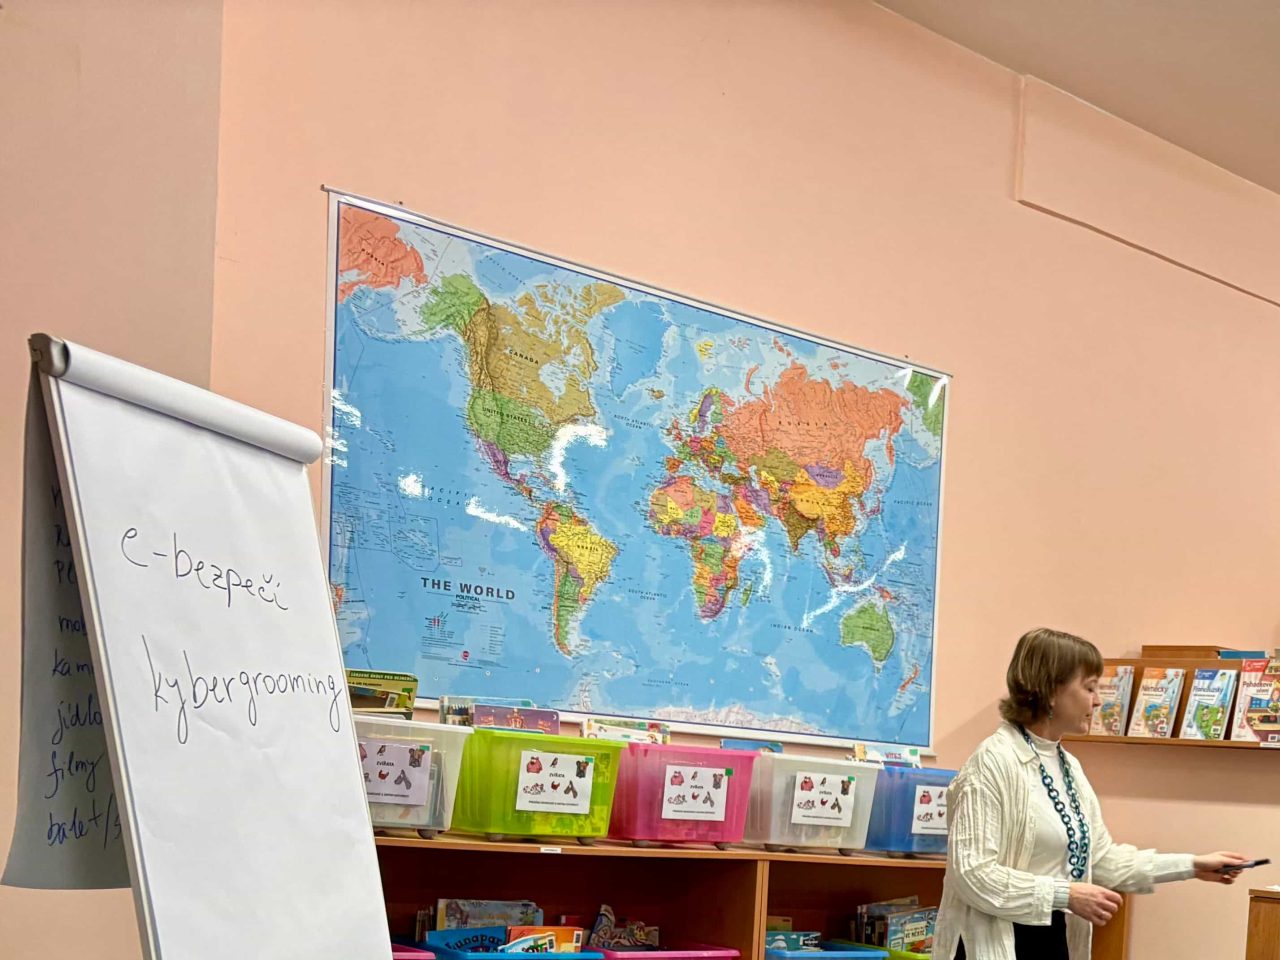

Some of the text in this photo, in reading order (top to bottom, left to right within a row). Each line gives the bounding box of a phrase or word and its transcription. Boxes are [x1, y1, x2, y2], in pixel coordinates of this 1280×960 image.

[508, 348, 540, 365] CANADA
[420, 577, 516, 600] THE WORLD
[455, 594, 481, 602] POLITICAL
[141, 633, 343, 745] kybergrooming
